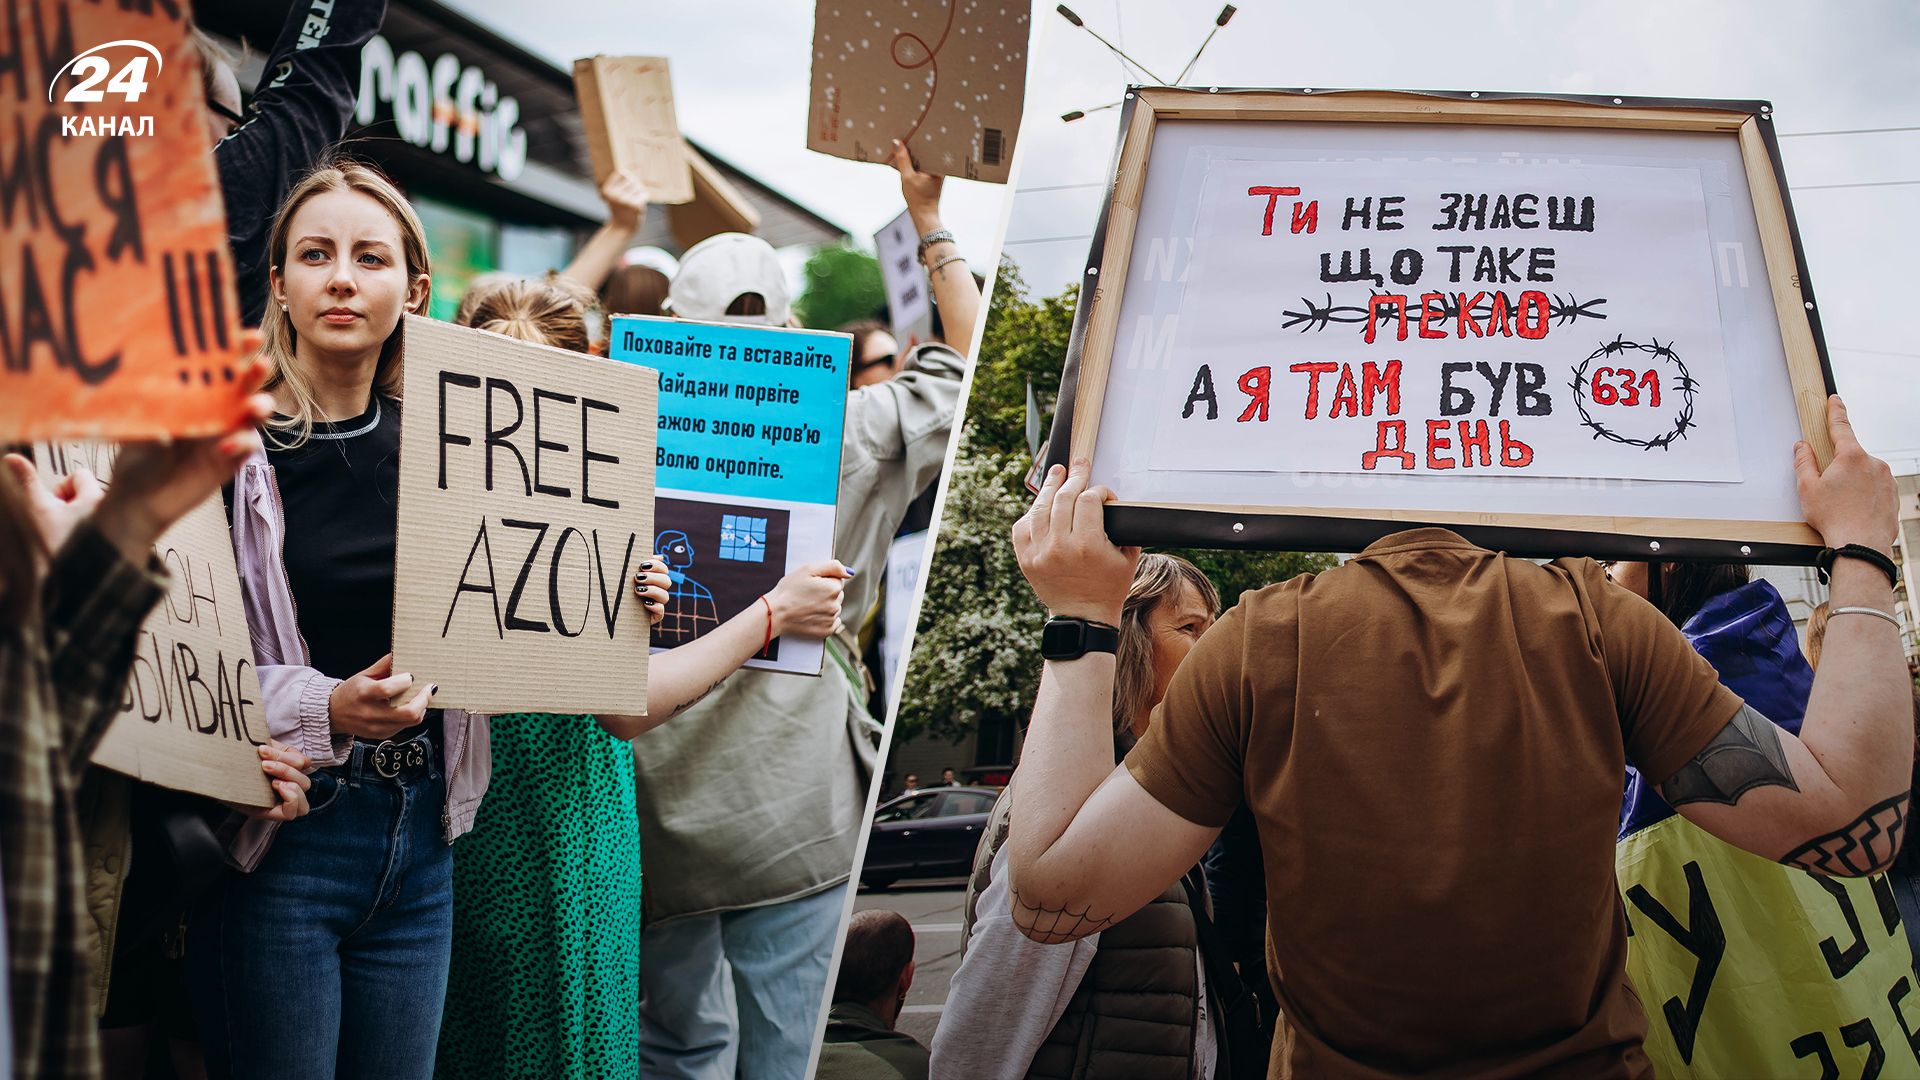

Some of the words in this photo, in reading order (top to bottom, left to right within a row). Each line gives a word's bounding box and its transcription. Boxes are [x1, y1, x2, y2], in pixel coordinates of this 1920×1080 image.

[355, 34, 528, 182] raffic
[1341, 196, 1406, 232] НЕ
[1431, 192, 1596, 233] ЗНАЄШ
[1319, 246, 1425, 288] ЩО
[1436, 245, 1556, 284] ТАКЕ
[1363, 289, 1552, 345] ПЕКЛО
[622, 331, 712, 359] Поховайте
[718, 344, 737, 361] та
[743, 346, 837, 374] вставайте,
[734, 382, 800, 406] порвіте
[1181, 363, 1219, 421] А
[1236, 365, 1272, 423] Я
[1289, 359, 1403, 422] ТАМ
[1438, 361, 1553, 419] БУВ
[1591, 367, 1661, 407] 631
[437, 370, 620, 510] FREE
[657, 414, 706, 434] ажою
[711, 419, 756, 439] злою
[1362, 418, 1534, 470] ДЕНЬ
[656, 446, 700, 471] Волю
[705, 456, 784, 480] окропіте.
[441, 515, 636, 640] AZOV
